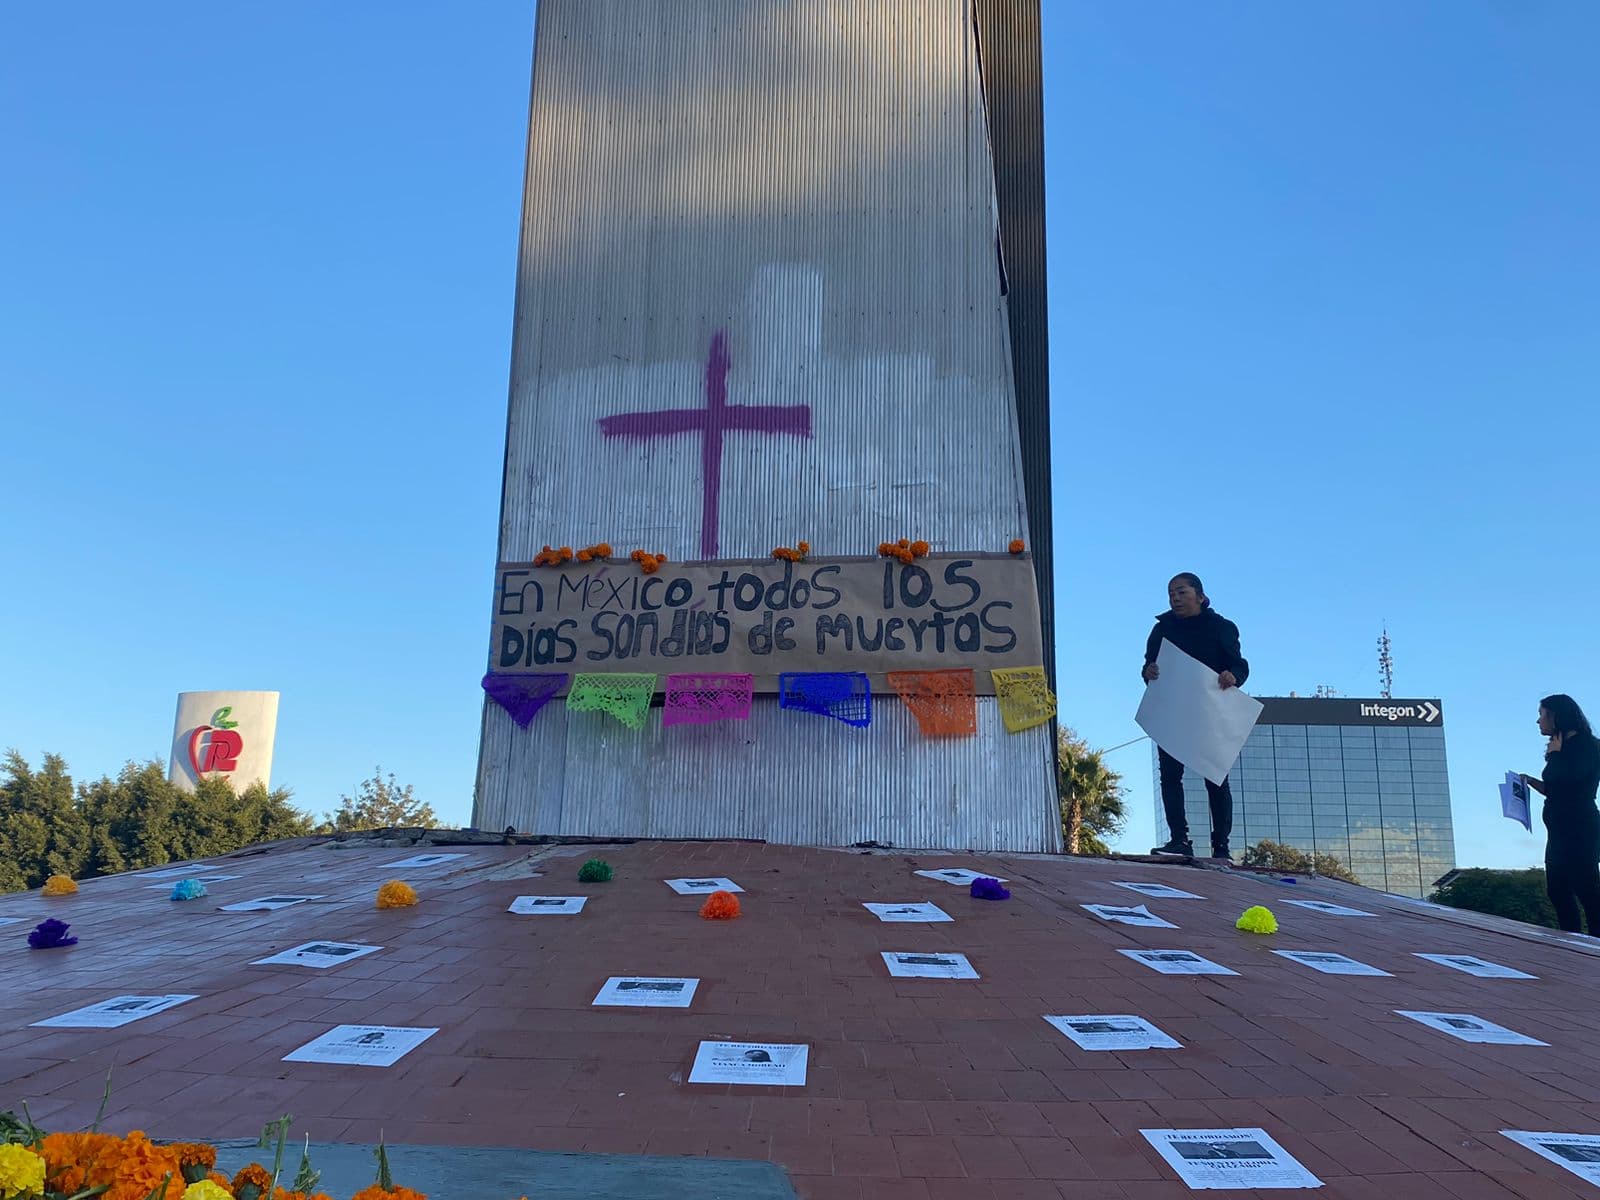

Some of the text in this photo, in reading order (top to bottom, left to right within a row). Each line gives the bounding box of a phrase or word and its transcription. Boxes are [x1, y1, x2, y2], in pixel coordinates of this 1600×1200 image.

[499, 560, 982, 615] En México todos los
[499, 621, 578, 667] Días
[748, 611, 797, 655] de
[1360, 703, 1415, 720] Integon
